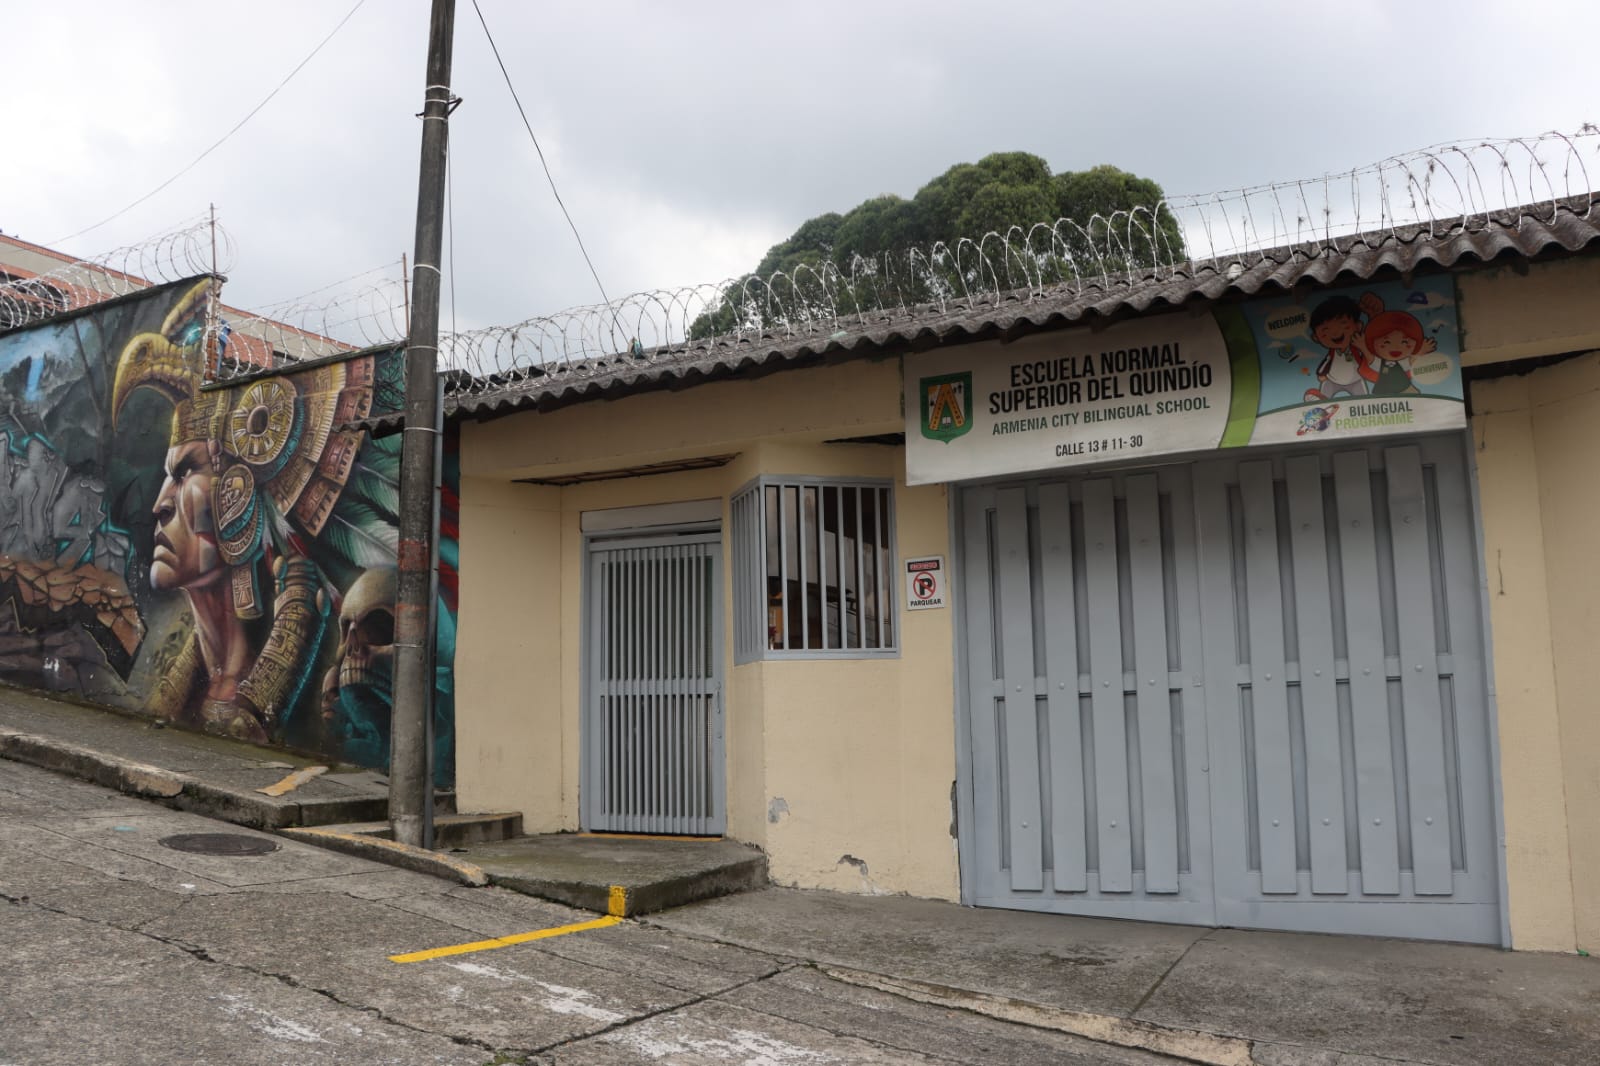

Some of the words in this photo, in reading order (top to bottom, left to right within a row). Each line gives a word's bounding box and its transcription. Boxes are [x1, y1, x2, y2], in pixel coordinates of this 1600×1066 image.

[1269, 313, 1306, 331] WELCOME
[1010, 355, 1095, 387] ESCUELA
[1101, 343, 1186, 375] NORMAL
[989, 383, 1081, 414] SUPERIOR
[1087, 377, 1124, 401] DEL
[1129, 361, 1212, 396] QUINDÍO
[992, 416, 1048, 435] ARMENIA
[1052, 412, 1079, 428] CITY
[1083, 404, 1152, 424] BILINGUAL
[1156, 396, 1211, 415] SCHOOL
[1349, 401, 1413, 417] BILINGUAL
[1335, 412, 1414, 430] PROGRAMME
[1055, 442, 1084, 457] CALLE
[1088, 440, 1099, 453] 13
